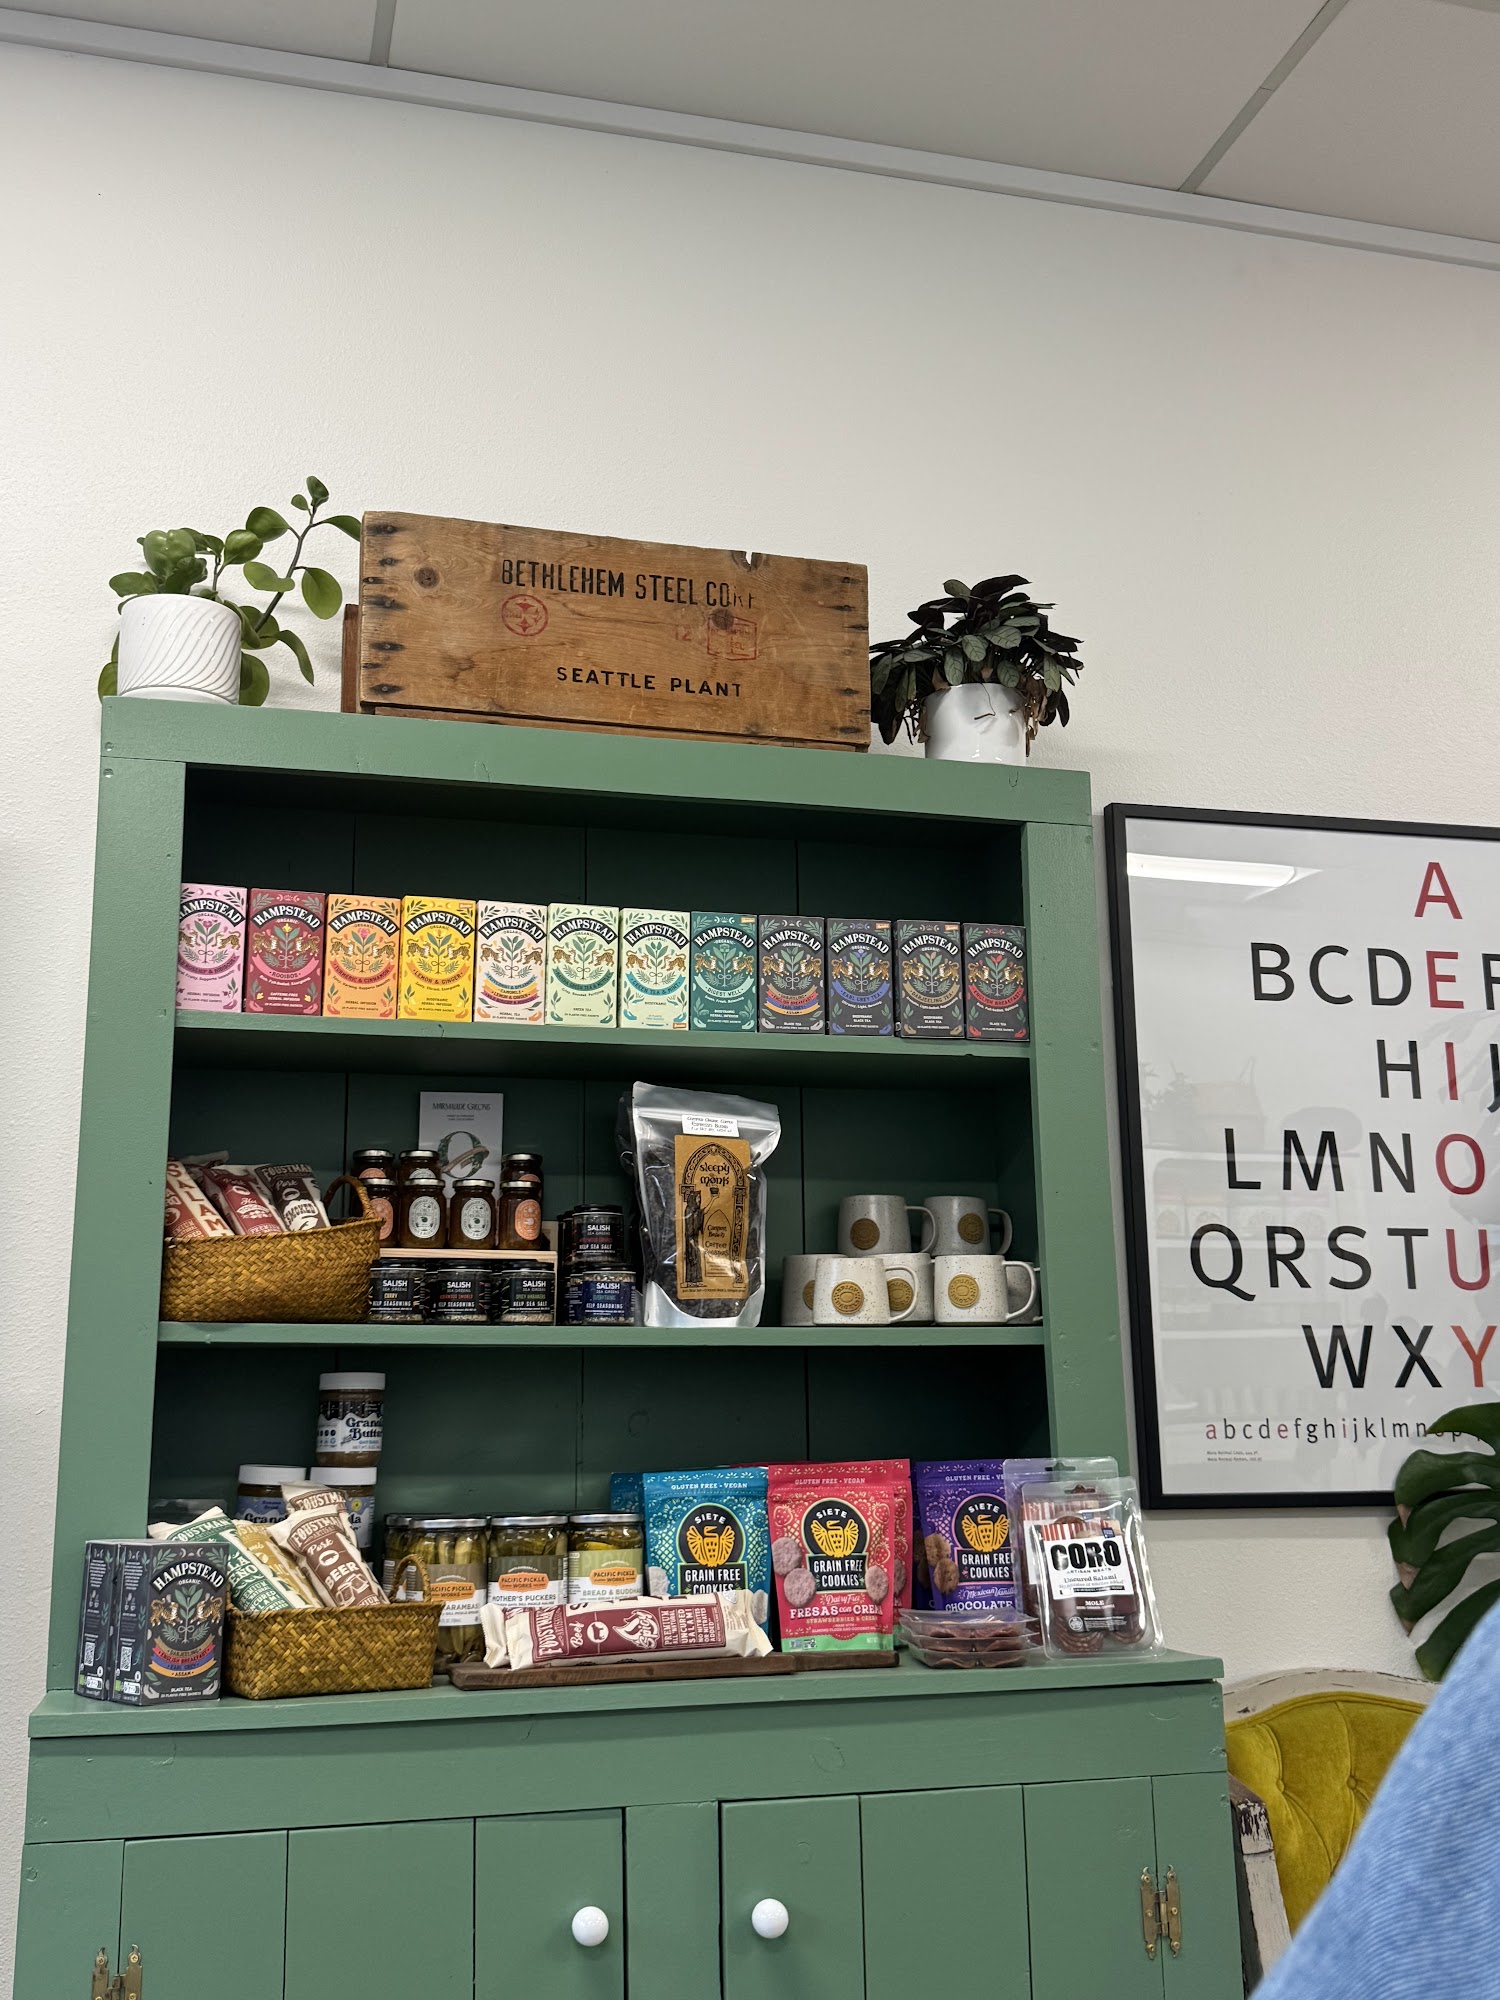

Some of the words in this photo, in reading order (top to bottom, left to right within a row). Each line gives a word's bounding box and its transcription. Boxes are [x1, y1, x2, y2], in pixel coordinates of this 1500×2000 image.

[502, 559, 624, 598] BETHLEHEM
[636, 574, 699, 605] STEEL
[556, 666, 656, 690] SEATTLE
[670, 677, 742, 698] PLANT
[1414, 861, 1463, 920] A
[253, 905, 320, 929] HAMPSTEAD
[331, 910, 397, 933] HAMPSTEAD
[407, 911, 472, 936] HAMPSTEAD
[481, 917, 544, 941] HAMPSTEAD
[553, 918, 616, 942] HAMPSTEAD
[626, 924, 686, 947] HAMPSTEAD
[694, 926, 755, 949] HAMPSTEAD
[762, 929, 822, 952] HAMPSTEAD
[830, 933, 890, 955] HAMPSTEAD
[901, 934, 959, 956] HAMPSTEAD
[967, 938, 1024, 959] HAMPSTEAD
[271, 972, 299, 980] ROOIBOS
[414, 969, 432, 983] LEMON
[441, 973, 462, 984] GINGER
[632, 979, 650, 994] GREEN
[707, 987, 726, 997] DIGEST
[727, 988, 742, 996] WELL
[842, 991, 855, 1002] EARL
[856, 995, 870, 1003] GREY
[871, 992, 881, 1001] TEA
[911, 991, 943, 1004] DARJEELING
[943, 992, 953, 1002] TEA
[973, 989, 993, 1005] ENGLISH
[994, 991, 1022, 1006] BREAKFAST
[699, 1161, 730, 1175] sleepy
[1224, 1127, 1486, 1196] LMNO
[275, 1179, 298, 1191] Pork
[700, 1174, 730, 1187] monk
[167, 1162, 229, 1236] SALAM
[284, 1203, 317, 1227] SMOKED
[587, 1224, 611, 1232] SALISH
[1190, 1223, 1491, 1302] QRSTU
[382, 1279, 408, 1287] SALISH
[446, 1281, 472, 1289] SALISH
[522, 1280, 547, 1288] SALISH
[596, 1282, 620, 1290] SALISH
[1301, 1324, 1498, 1389] WXY
[795, 1478, 821, 1486] GLUTEN
[821, 1477, 838, 1485] FREE
[843, 1476, 866, 1484] VEGAN
[945, 1474, 972, 1482] GLUTEN
[671, 1483, 700, 1491] GLUTEN
[700, 1482, 718, 1490] FREE
[724, 1481, 749, 1489] VEGAN
[816, 1507, 848, 1520] SIETE
[967, 1502, 1001, 1515] SIETE
[694, 1512, 727, 1525] SIETE
[307, 1537, 334, 1556] Pork
[961, 1553, 991, 1566] GRAIN
[993, 1552, 1015, 1565] FREE
[1050, 1540, 1122, 1572] CORO
[813, 1558, 842, 1573] GRAIN
[845, 1558, 864, 1573] FREE
[969, 1565, 1010, 1579] COOKIES
[152, 1561, 224, 1591] HAMPSTEAD
[178, 1578, 202, 1586] ORGANIC
[324, 1561, 360, 1591] BEER
[593, 1571, 614, 1579] PACIFIC
[684, 1568, 715, 1582] GRAIN
[717, 1567, 741, 1581] FREE
[821, 1573, 860, 1588] COOKIES
[1063, 1575, 1093, 1584] Uncured
[1092, 1573, 1118, 1581] Salami
[692, 1583, 735, 1595] COOKIES
[962, 1587, 995, 1600] Mexican
[525, 1593, 556, 1602] PUCKERS
[789, 1605, 839, 1620] FRESAS
[839, 1606, 853, 1614] con
[805, 1616, 855, 1624] STRAWBERRIES
[638, 1612, 660, 1650] Spicy
[660, 1609, 673, 1646] PREMIUM
[677, 1608, 689, 1644] UNCURED
[684, 1608, 697, 1644] SALAMI
[568, 1620, 586, 1649] Beef
[698, 1633, 704, 1643] NO
[704, 1633, 710, 1643] OR
